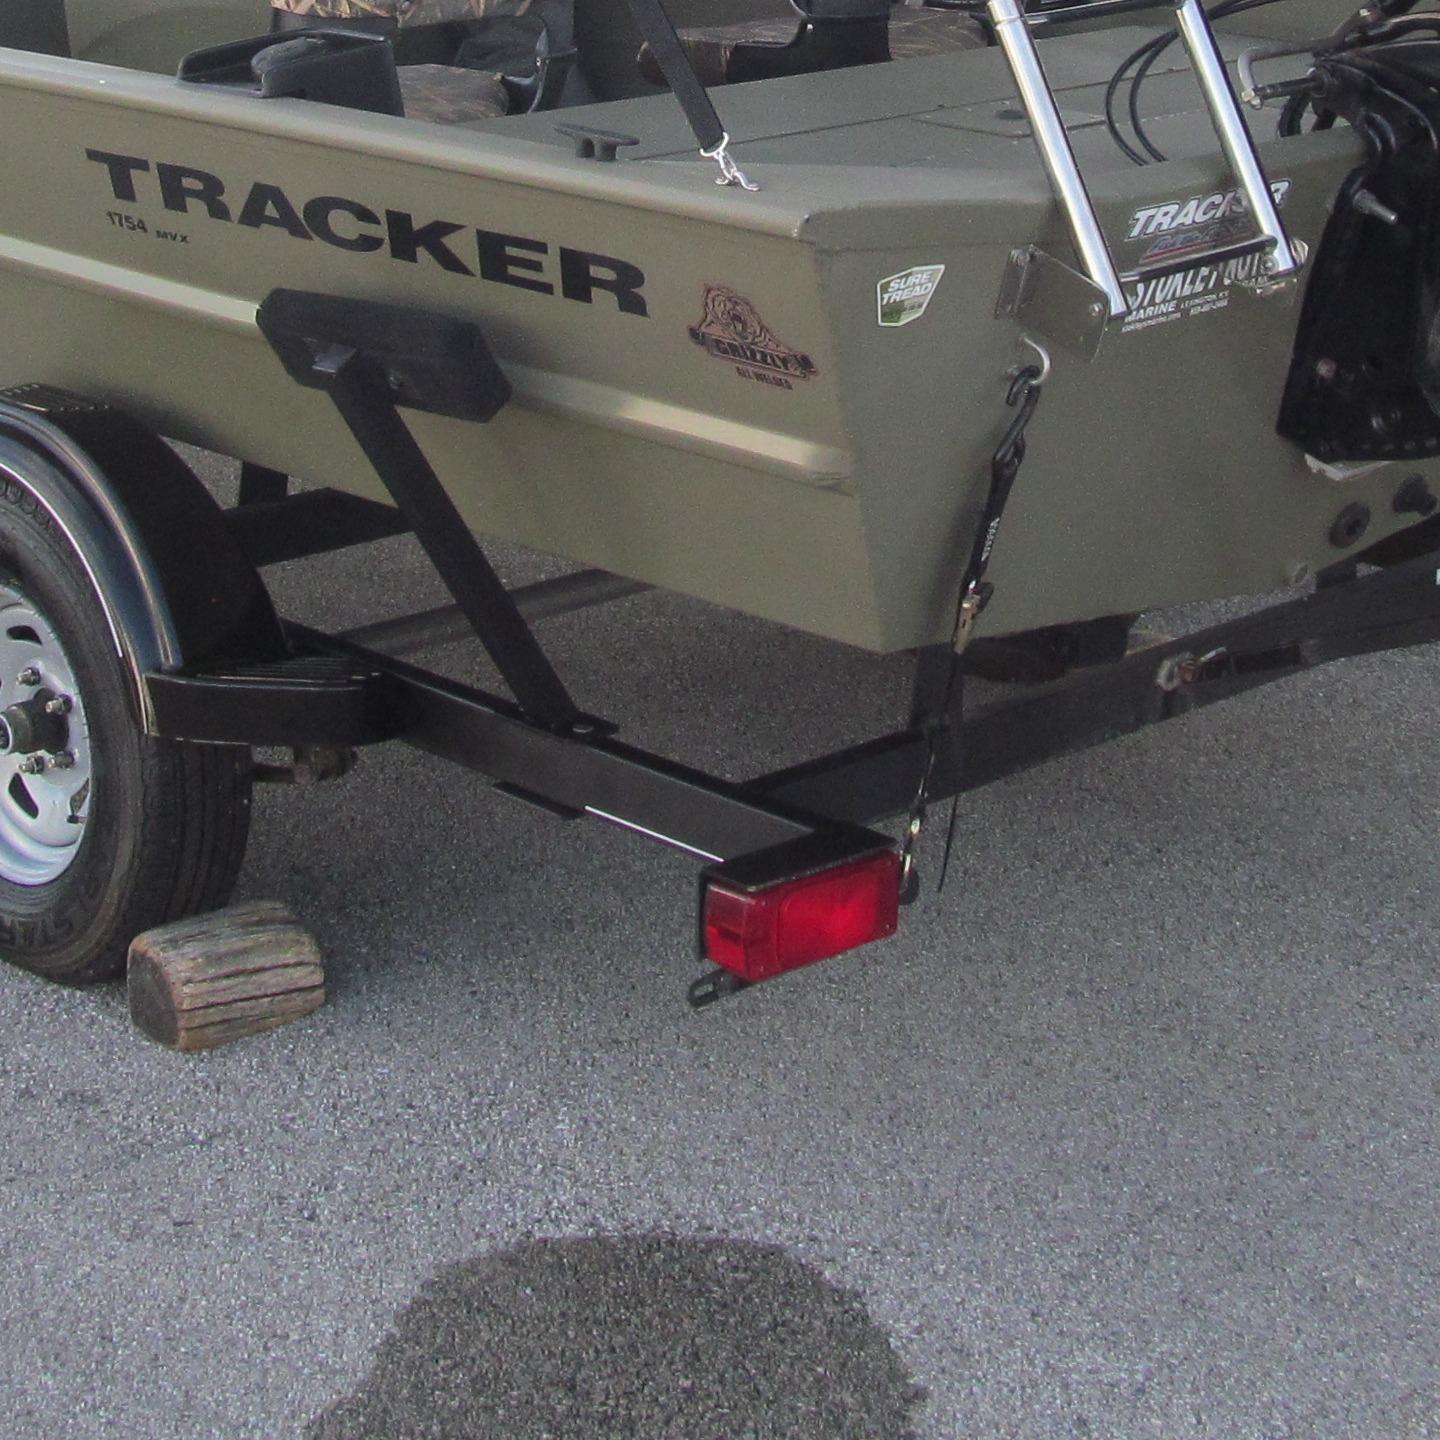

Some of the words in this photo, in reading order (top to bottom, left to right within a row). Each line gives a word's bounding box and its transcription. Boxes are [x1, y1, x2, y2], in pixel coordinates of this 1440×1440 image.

[1125, 178, 1292, 241] TRACKR
[85, 147, 650, 319] TRACKER
[106, 211, 148, 233] 1754
[888, 271, 932, 292] SURE
[882, 283, 932, 306] TREAD
[1124, 300, 1177, 323] MARINE
